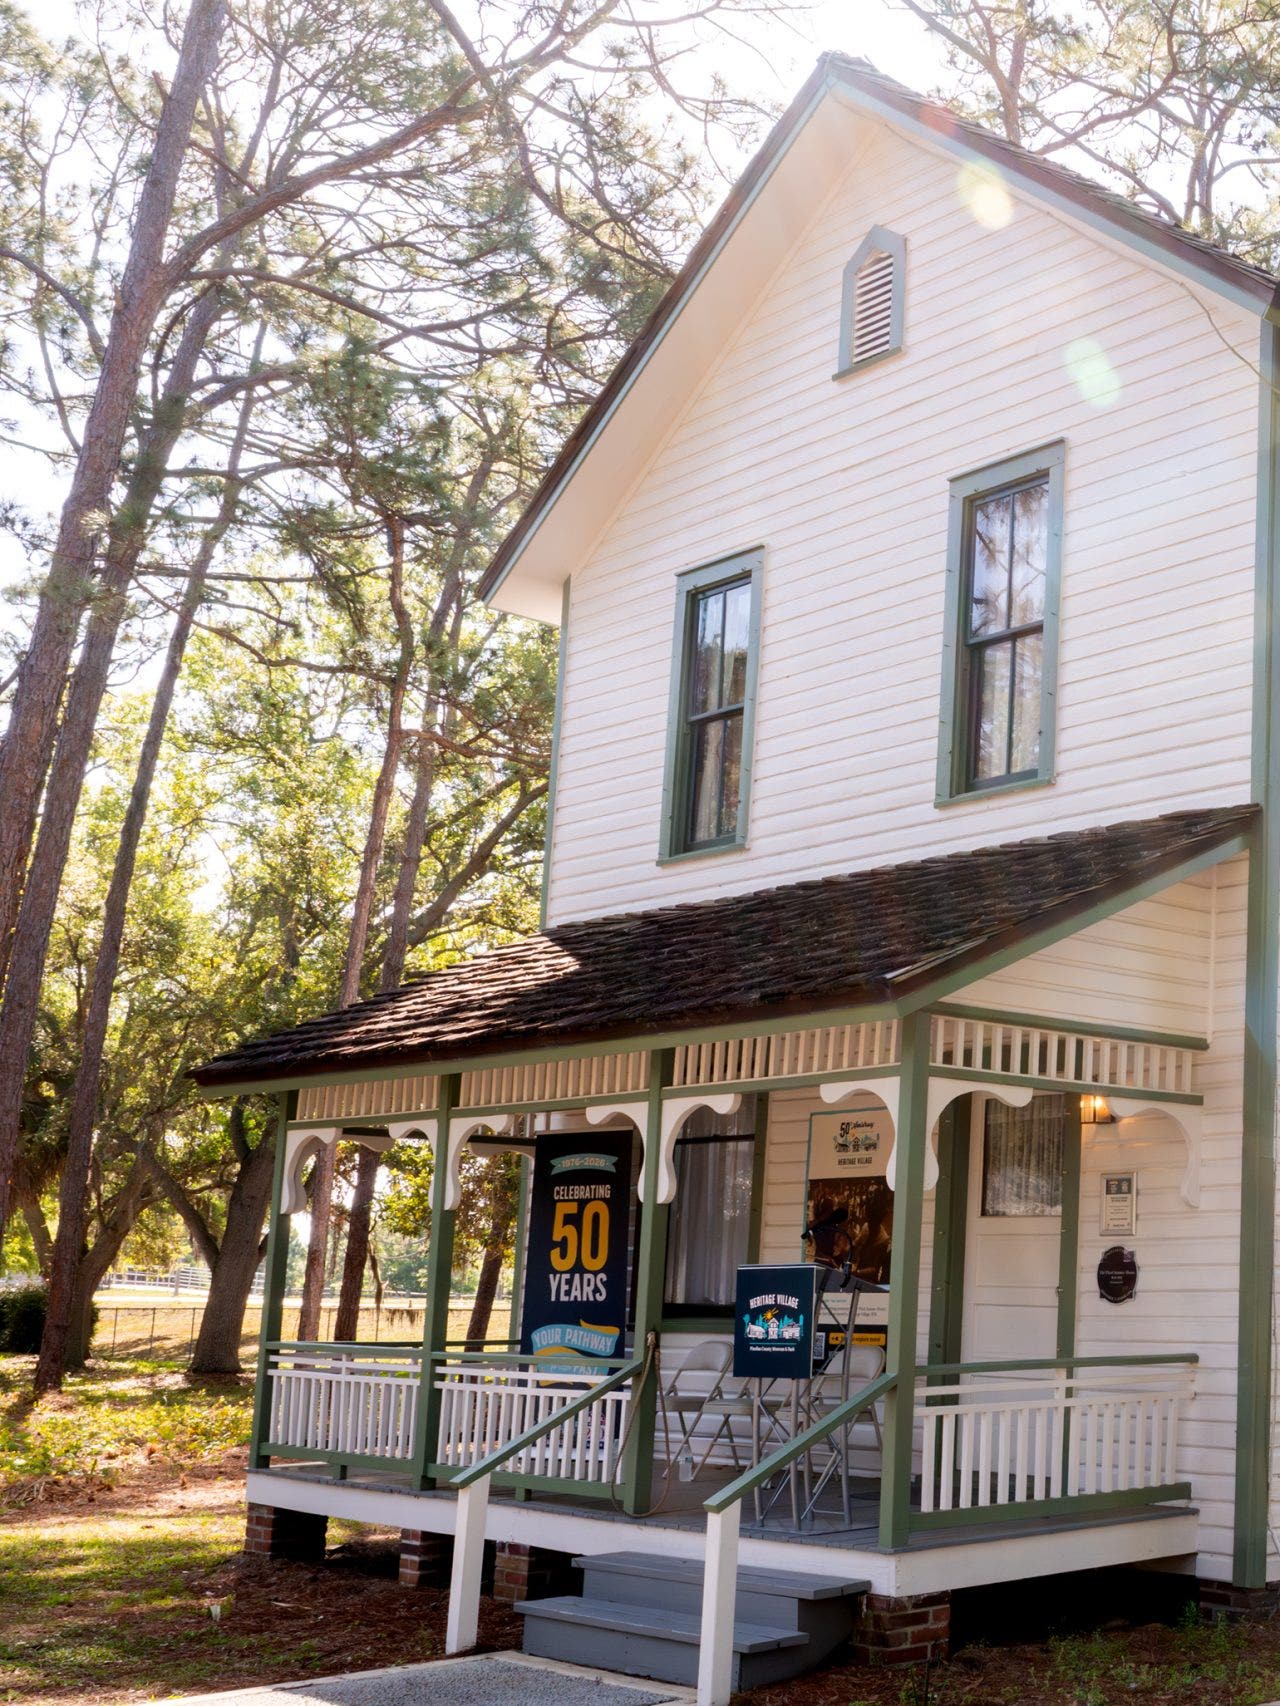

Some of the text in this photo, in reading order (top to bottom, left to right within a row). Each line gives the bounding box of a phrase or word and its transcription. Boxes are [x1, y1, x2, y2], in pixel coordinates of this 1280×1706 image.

[553, 1184, 612, 1200] CELEBRATING
[550, 1200, 610, 1272] 50
[548, 1272, 608, 1302] YEARS
[749, 1293, 799, 1310] HERITAGE VILLAGE
[533, 1327, 613, 1353] YOUR PATHWAY
